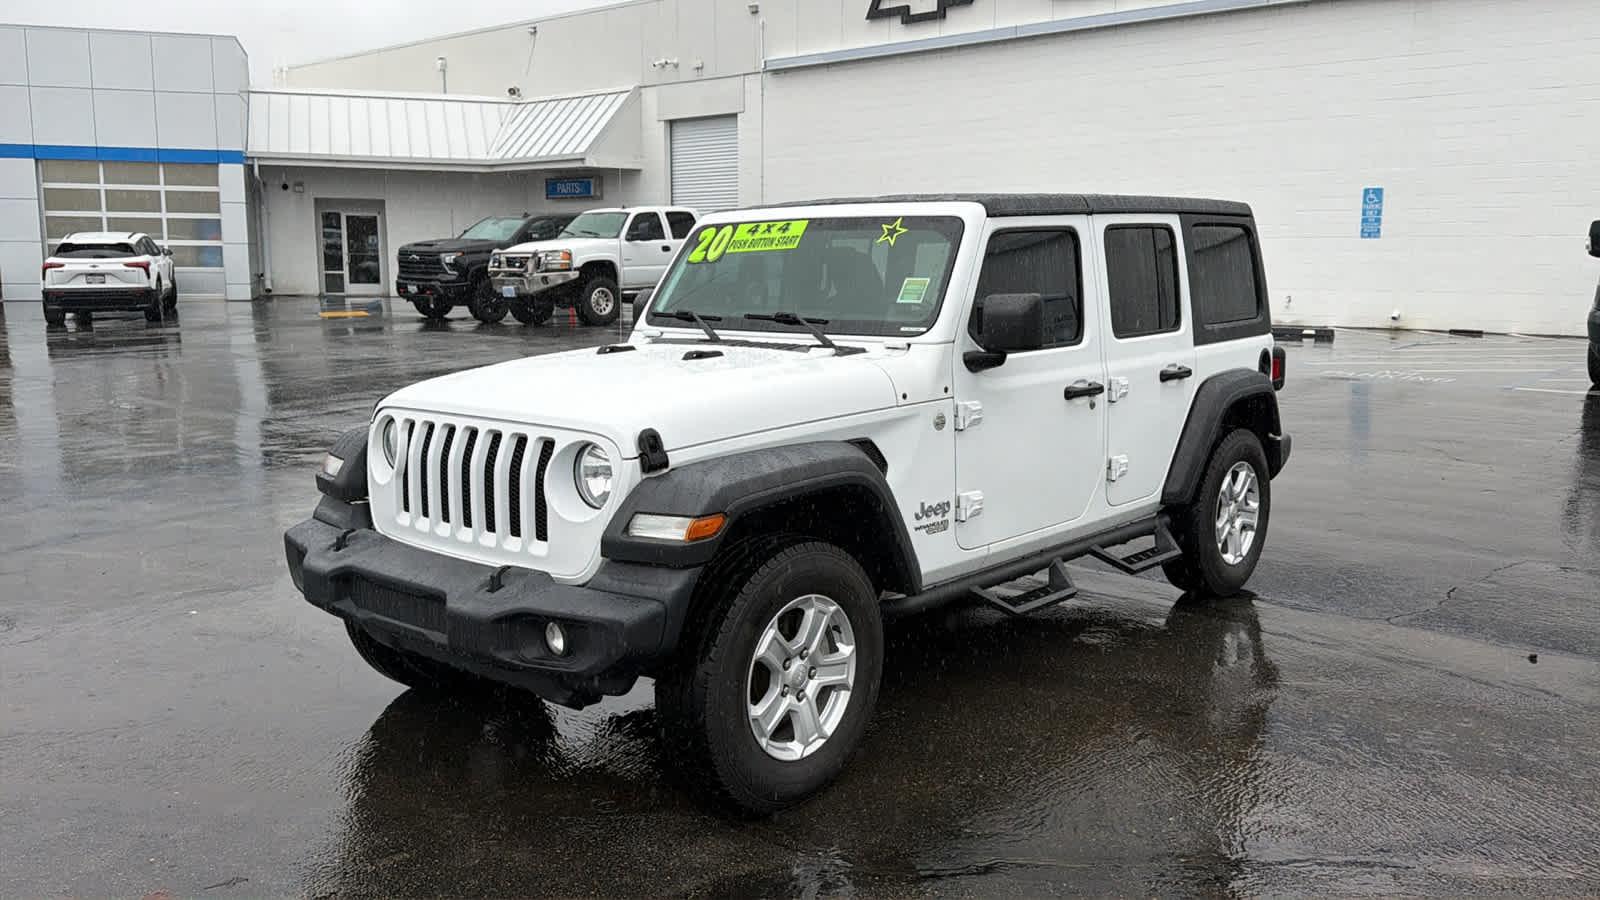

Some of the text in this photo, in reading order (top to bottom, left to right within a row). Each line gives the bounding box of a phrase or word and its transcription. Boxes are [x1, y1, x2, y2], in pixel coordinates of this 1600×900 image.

[556, 182, 580, 193] PARTS
[688, 225, 733, 263] 20
[728, 235, 800, 250] PUSH BUTTON START
[914, 500, 950, 521] Jeep
